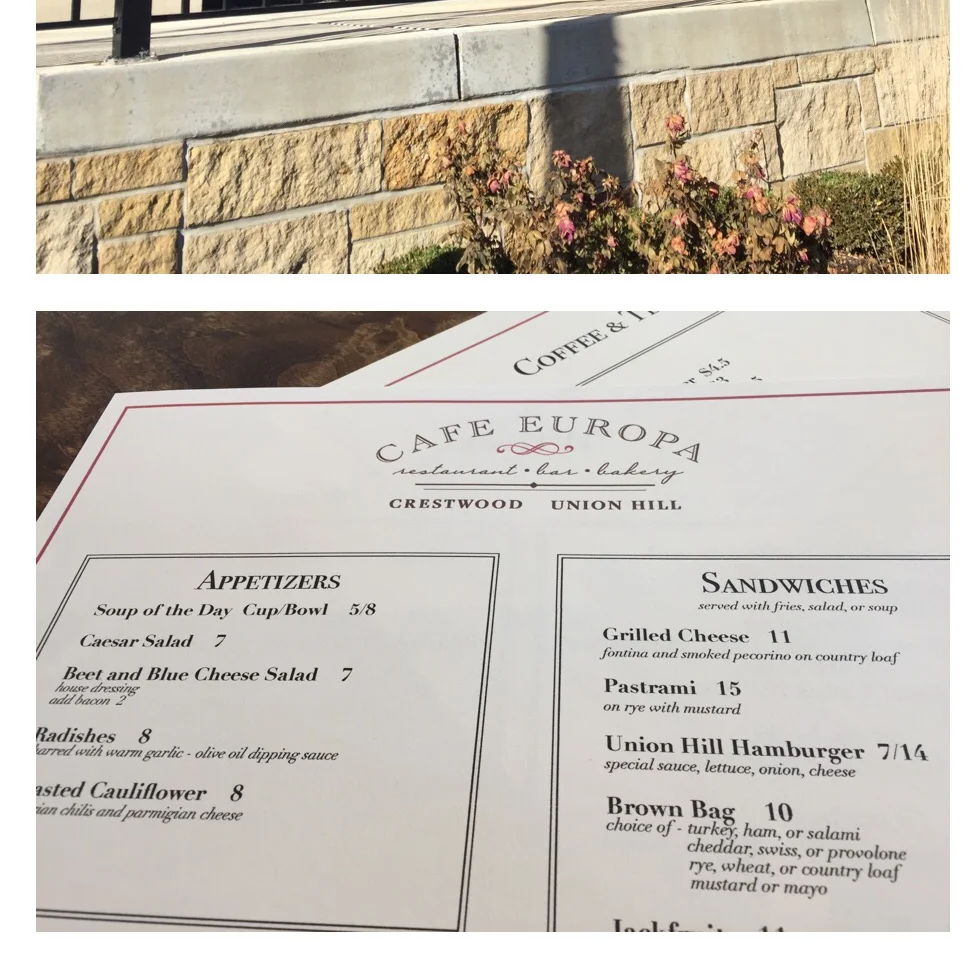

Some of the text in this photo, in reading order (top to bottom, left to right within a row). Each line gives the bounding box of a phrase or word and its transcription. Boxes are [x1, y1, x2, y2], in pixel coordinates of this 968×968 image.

[513, 329, 608, 376] COFFEE
[606, 322, 628, 333] &
[375, 415, 701, 463] CAFE EUROPA
[393, 461, 685, 484] restaurant bar bakery
[389, 498, 682, 510] CRESTWOOD UNION HILL
[196, 570, 341, 590] APPETIZERS
[702, 572, 888, 594] SANDWICHES
[93, 603, 376, 620] Soup of the Day Cup/Bowl 5/8
[698, 600, 739, 610] served
[742, 601, 770, 610] with
[771, 601, 805, 613] fries,
[808, 601, 847, 612] salad,
[868, 605, 898, 615] soup
[80, 634, 227, 648] Caesar Salad 7
[603, 627, 791, 643] Grilled Cheese 11
[599, 647, 648, 660] fontina
[652, 648, 679, 658] and
[681, 648, 731, 659] smoked
[732, 650, 791, 663] pecorino
[815, 654, 868, 665] country
[871, 651, 900, 665] loaf
[62, 666, 353, 682] Beet and Blue Cheese Salad 7
[55, 681, 140, 697] house dressing
[604, 678, 741, 696] Pastrami 15
[49, 694, 127, 706] add bacon 2
[624, 704, 646, 715] rye
[649, 702, 680, 713] with
[683, 703, 741, 715] mustard
[36, 727, 152, 744] Radishes 8
[75, 745, 103, 757] with
[106, 749, 143, 757] warm
[142, 746, 184, 762] garlic
[195, 747, 226, 759] olive
[228, 747, 247, 759] oil
[248, 747, 301, 764] dipping
[301, 752, 339, 760] sauce
[605, 735, 928, 765] Union Hill Hamburger 7/14
[604, 758, 856, 778] special sauce, lettuce, onion, cheese
[90, 781, 207, 801] Cauliflower
[230, 784, 244, 802] 8
[60, 803, 95, 816] chilis
[96, 804, 126, 817] and
[121, 806, 197, 824] parmigian
[199, 807, 243, 821] cheese
[607, 796, 793, 826] Brown Bag 10
[606, 817, 653, 832] choice
[656, 819, 676, 837] of
[688, 821, 738, 840] turkey,
[743, 822, 781, 841] ham,
[786, 830, 804, 839] or
[807, 825, 861, 841] salami
[687, 838, 907, 863] cheddar, swiss, or provolone
[689, 858, 903, 883] rye, wheat, or country loaf
[690, 877, 828, 899] mustard or mayo
